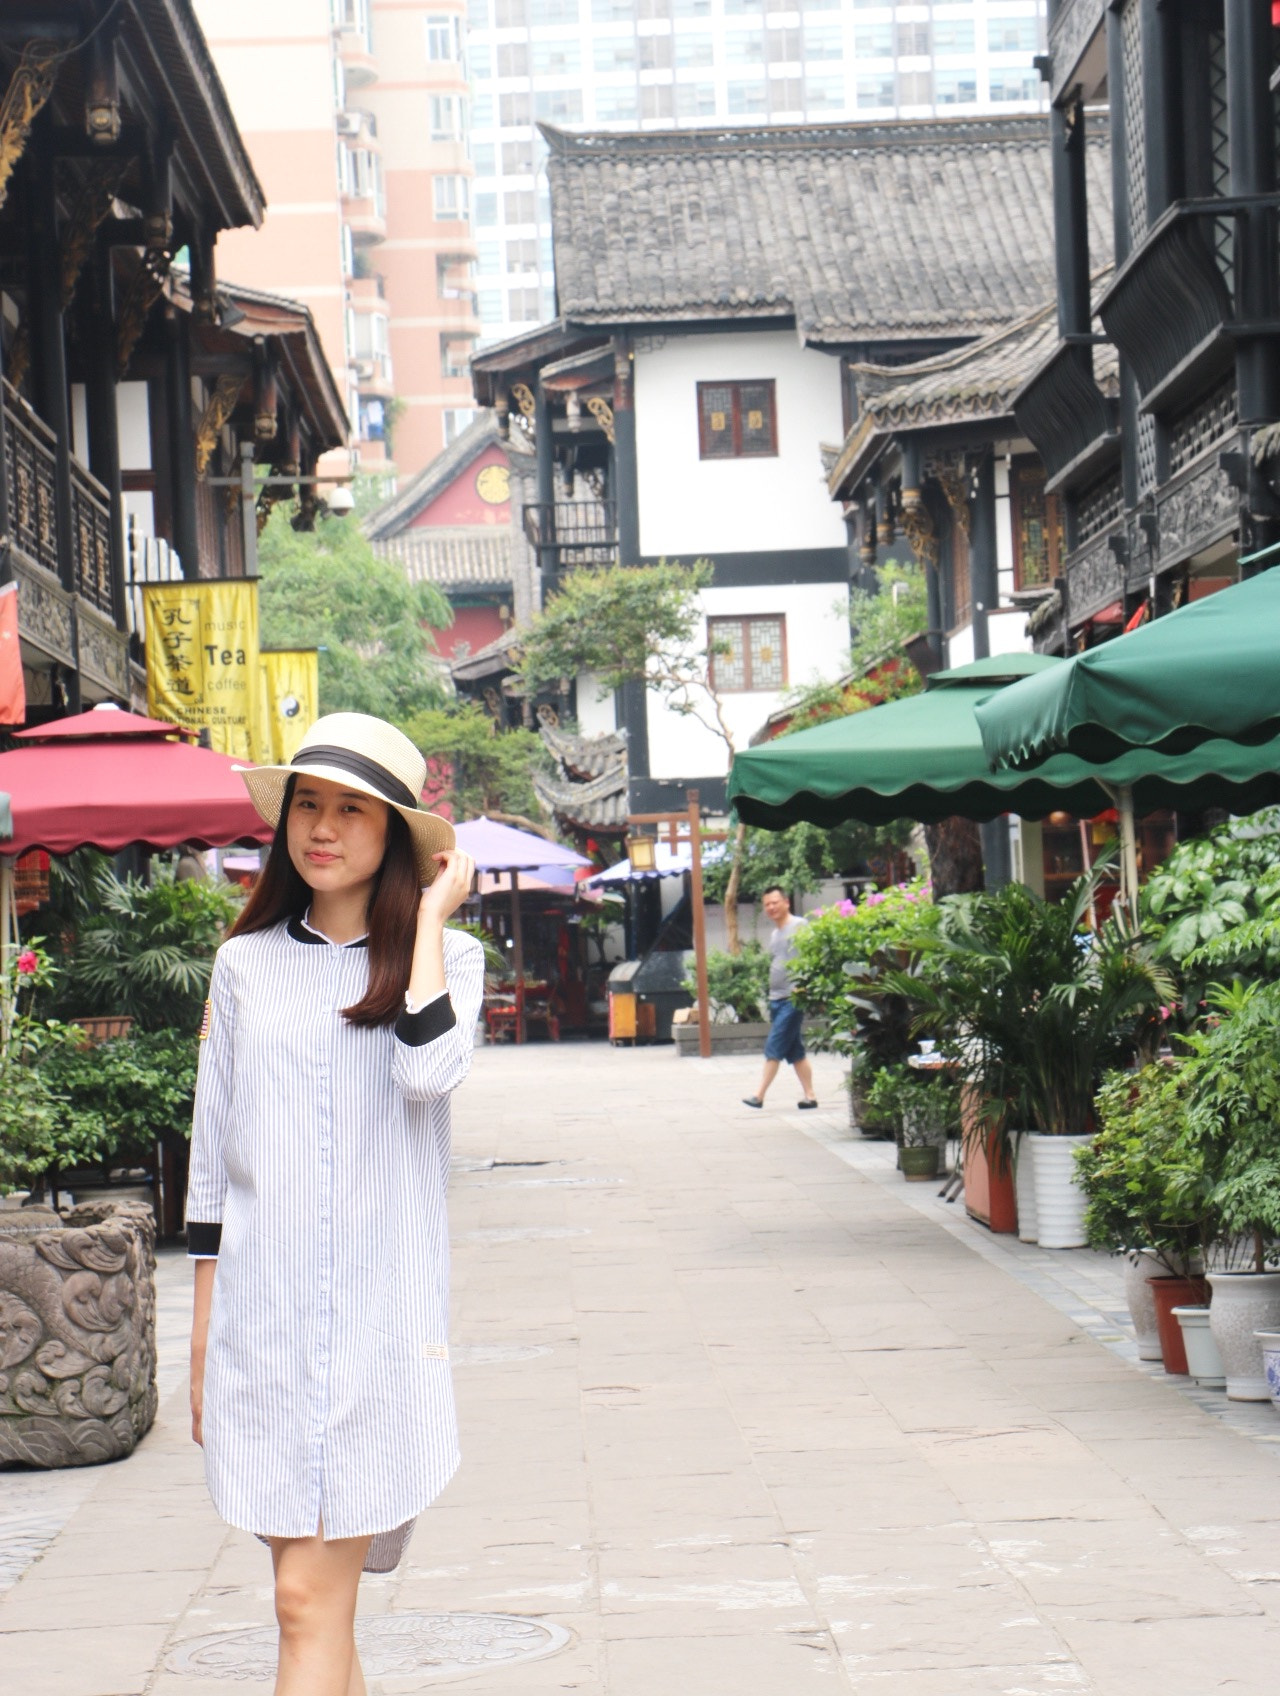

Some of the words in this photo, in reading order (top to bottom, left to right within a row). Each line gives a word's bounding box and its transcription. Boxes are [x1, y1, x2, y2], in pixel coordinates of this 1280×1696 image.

[204, 619, 246, 631] music
[162, 608, 194, 695] 孔子茶道
[204, 645, 246, 666] Tea
[207, 678, 247, 691] coffee
[176, 706, 227, 715] CHINESE
[211, 716, 246, 725] CULTURE
